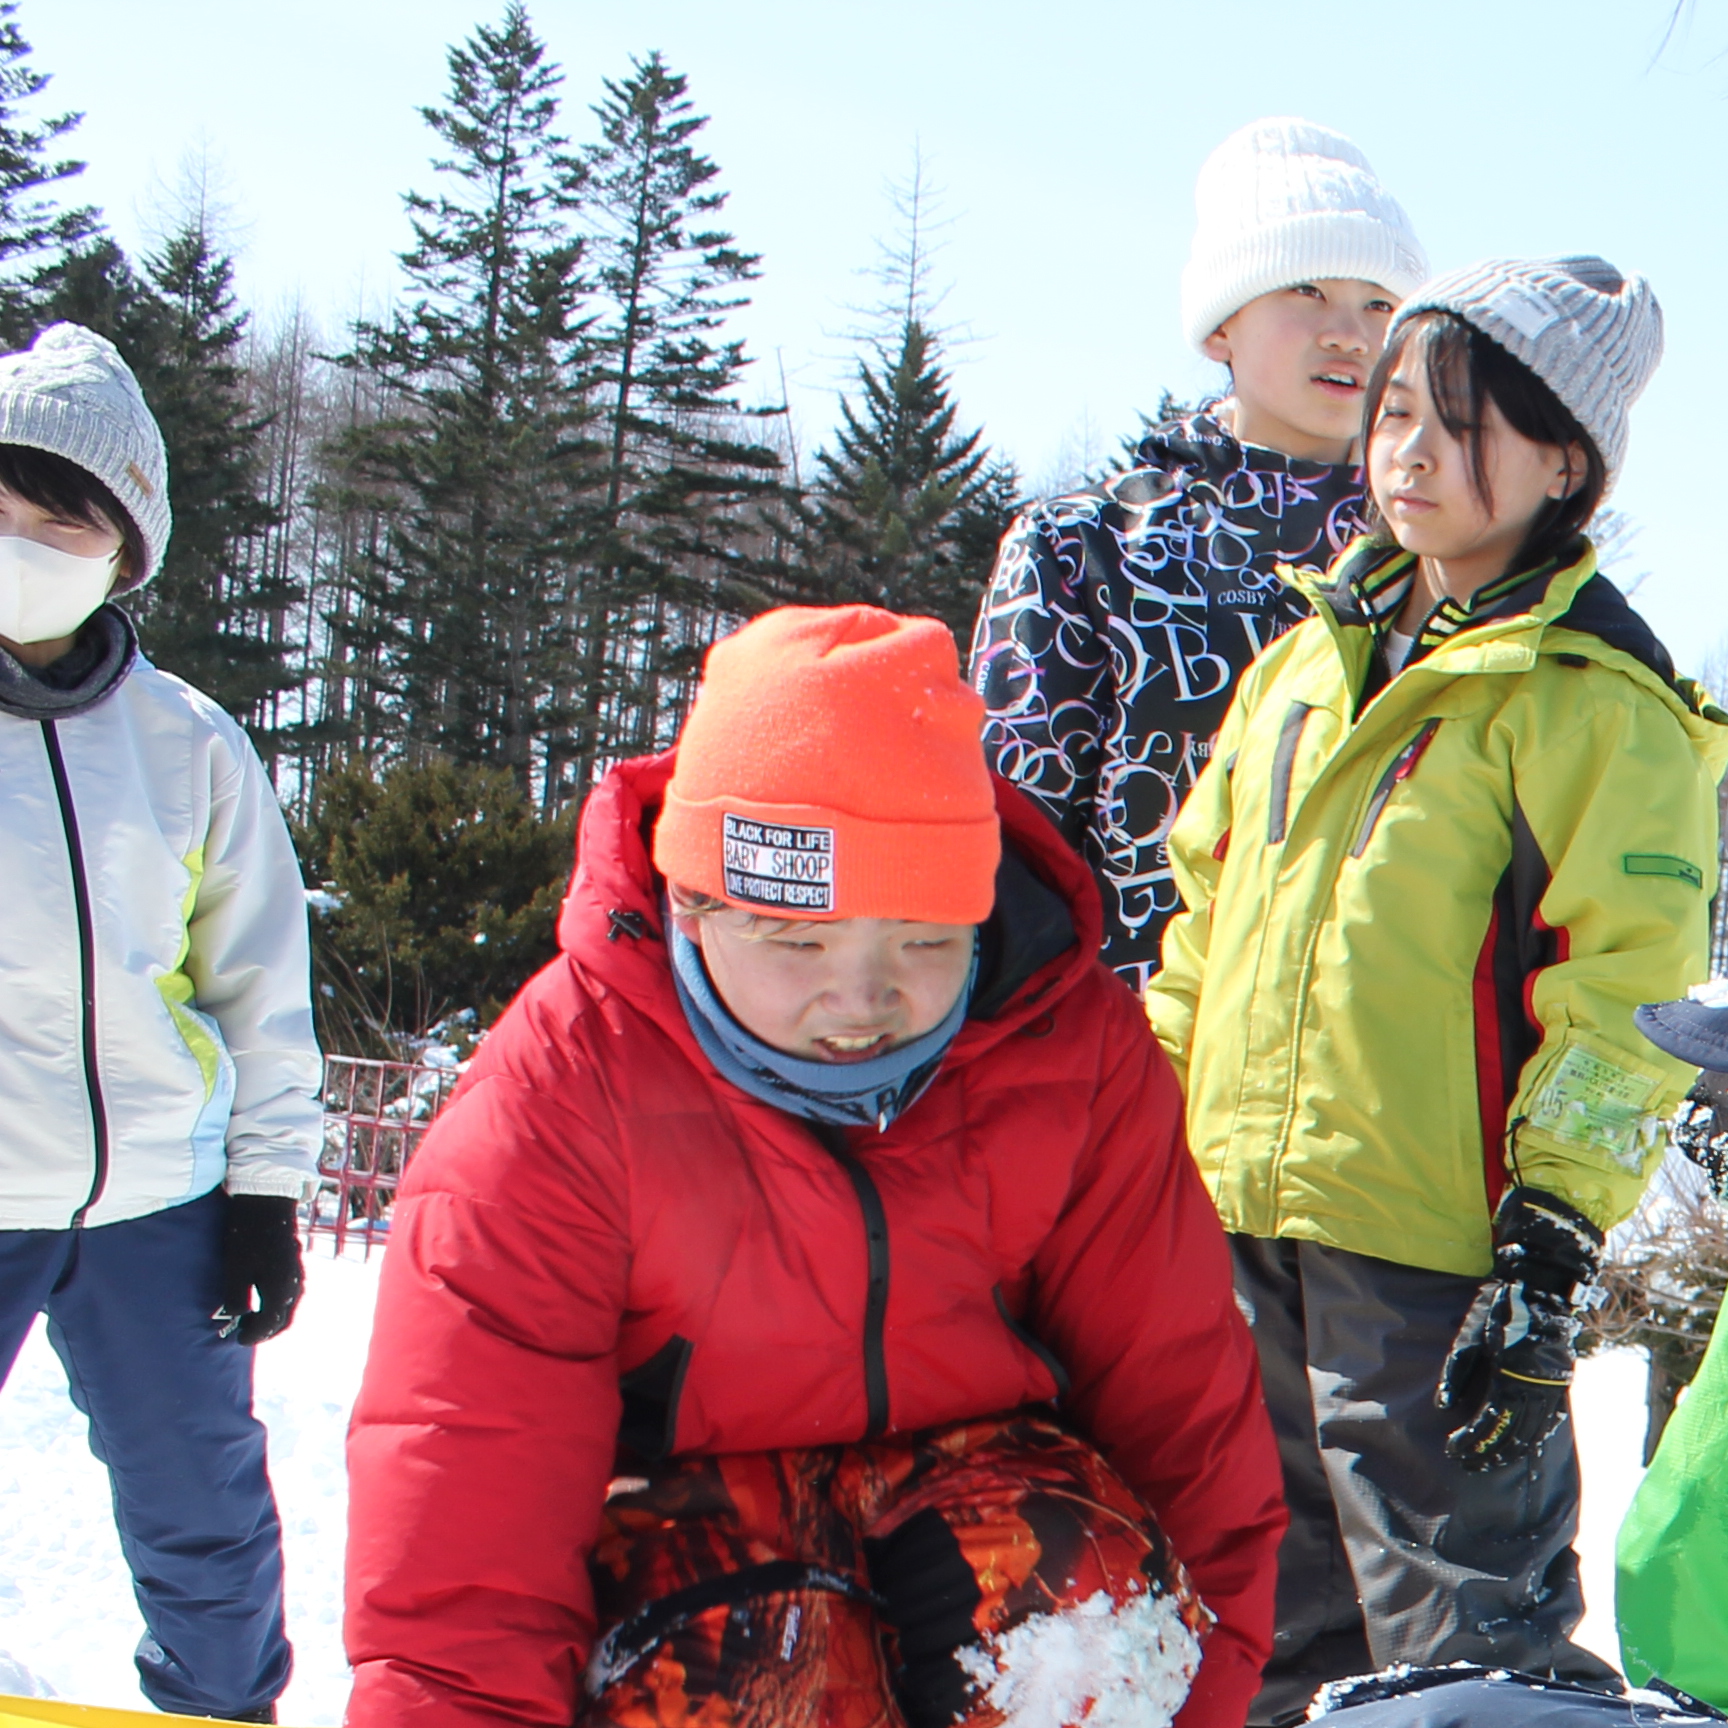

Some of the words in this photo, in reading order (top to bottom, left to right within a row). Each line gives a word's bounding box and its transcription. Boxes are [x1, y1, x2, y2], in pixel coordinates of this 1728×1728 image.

[1217, 589, 1267, 606] COSBY
[726, 819, 763, 844] BLACK
[765, 828, 793, 848] FOR
[796, 832, 830, 851] LIFE
[726, 840, 759, 872] BABY
[772, 850, 830, 879] SHOOP
[744, 877, 783, 902] PROTECT
[784, 883, 830, 906] RESPECT
